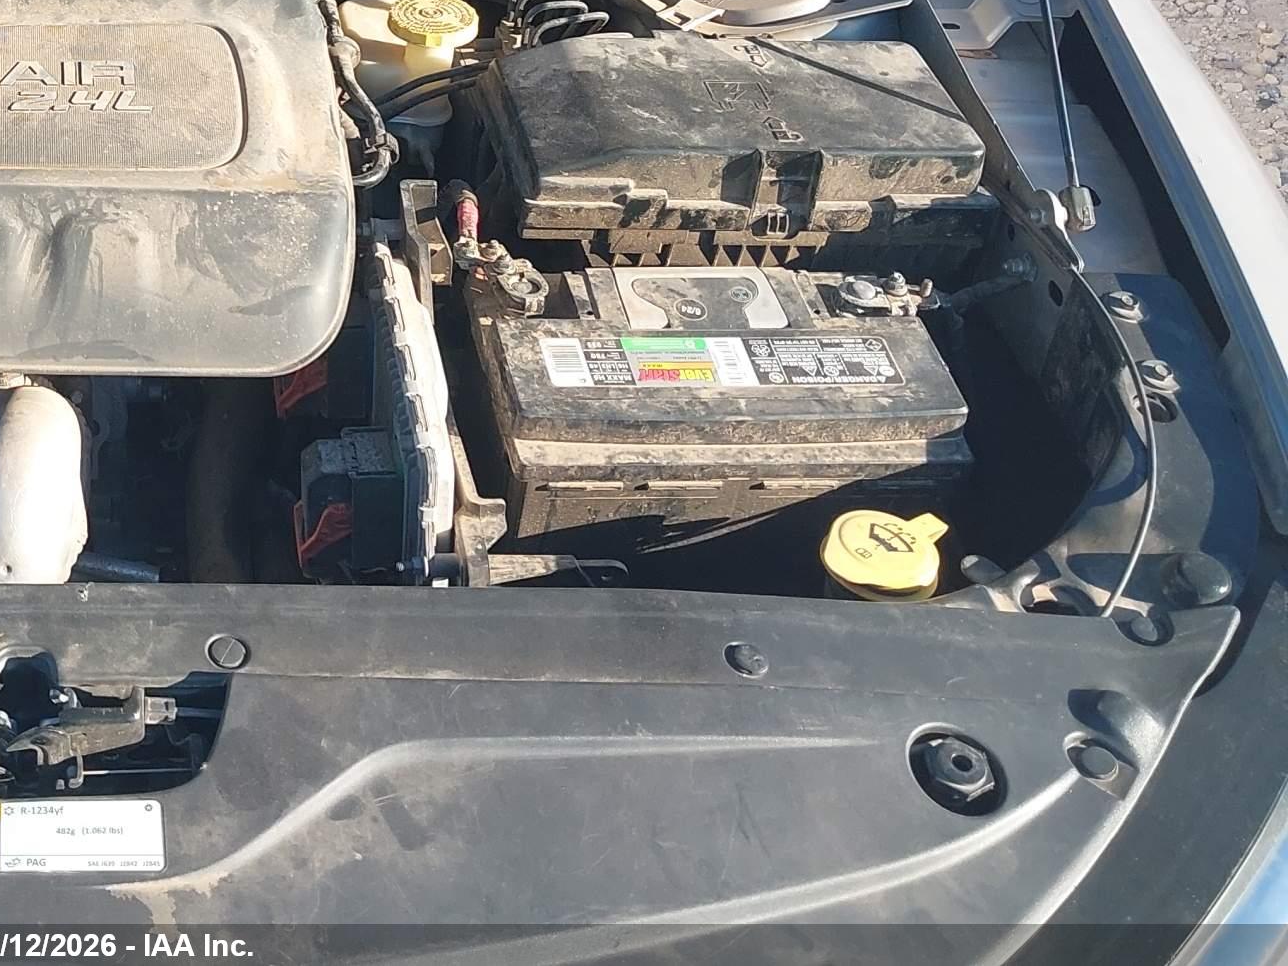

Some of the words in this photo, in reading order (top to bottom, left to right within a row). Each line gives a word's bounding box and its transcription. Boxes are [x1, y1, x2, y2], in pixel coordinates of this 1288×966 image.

[7, 90, 154, 113] 2.4L
[637, 369, 715, 383] EverStart
[20, 805, 64, 817] R-1234yf
[26, 858, 47, 867] PAG
